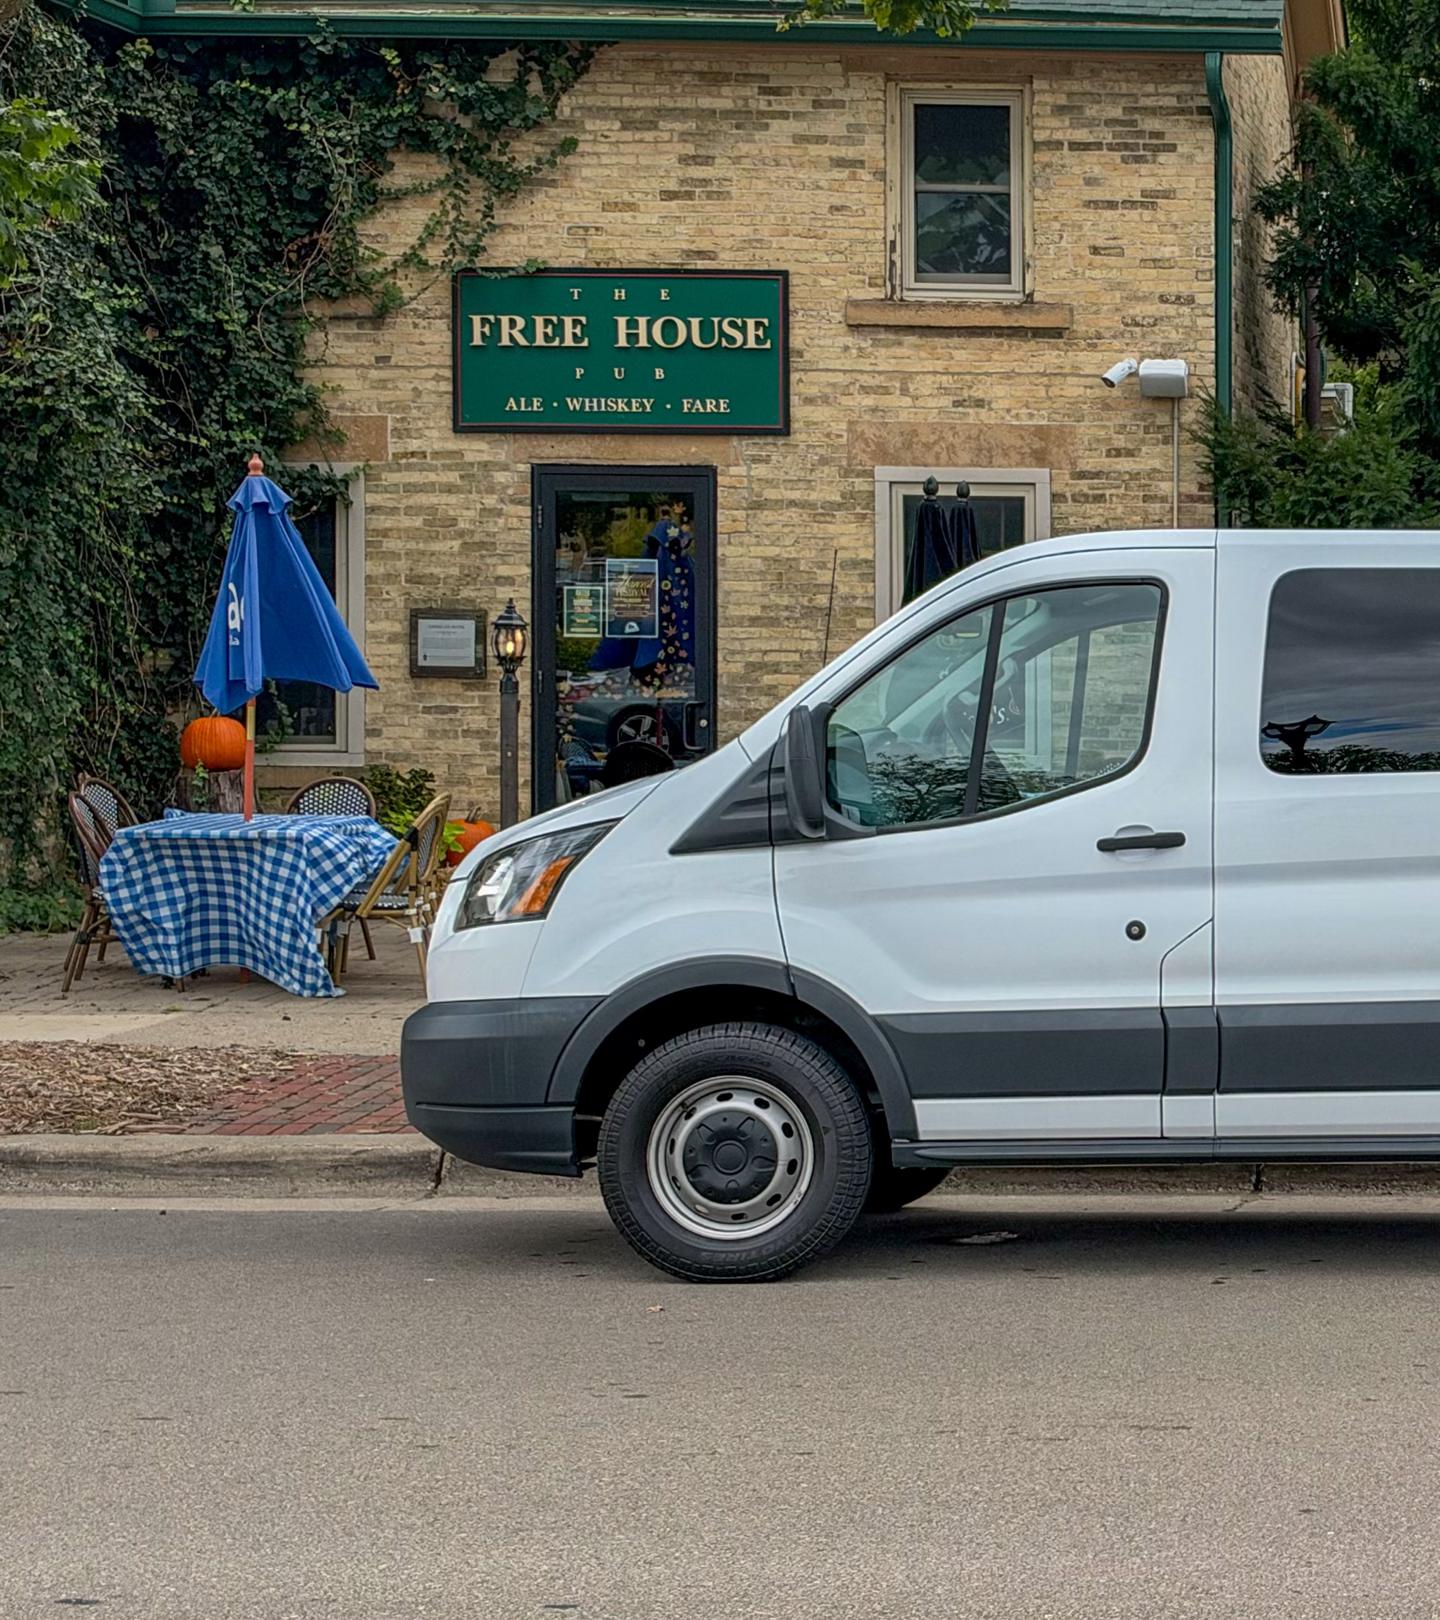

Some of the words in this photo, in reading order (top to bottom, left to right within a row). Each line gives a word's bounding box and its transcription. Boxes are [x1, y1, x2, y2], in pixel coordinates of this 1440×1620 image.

[570, 288, 670, 300] THE
[469, 314, 589, 347] FREE
[613, 316, 771, 349] HOUSE
[575, 367, 665, 379] PUB
[505, 397, 543, 412] ALE
[565, 397, 655, 413] WHISKEY
[682, 399, 730, 413] FARE
